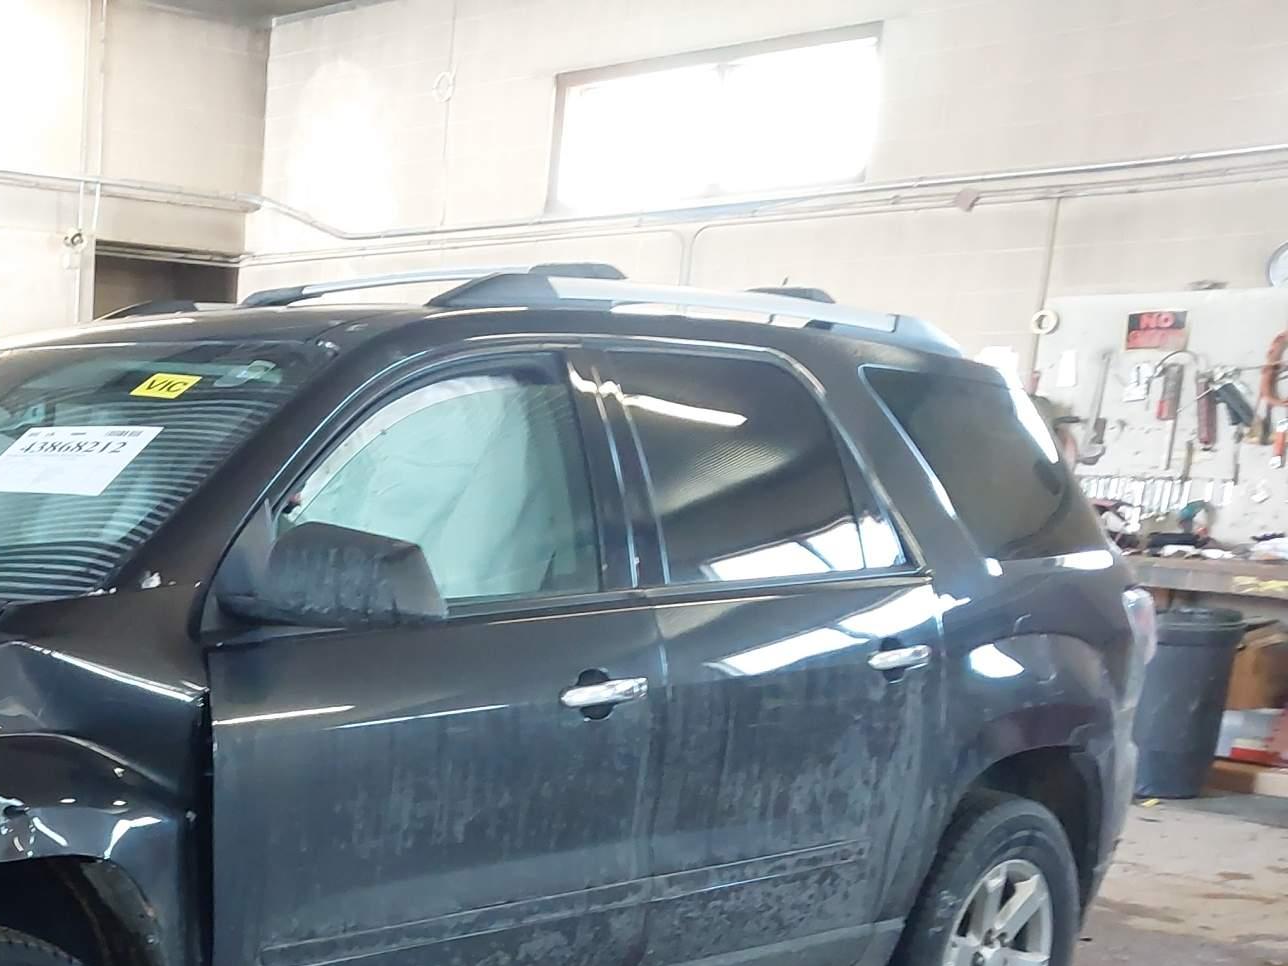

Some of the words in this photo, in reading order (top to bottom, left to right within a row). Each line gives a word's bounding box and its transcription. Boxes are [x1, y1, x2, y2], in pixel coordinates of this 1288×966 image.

[1140, 312, 1174, 328] NO
[145, 379, 187, 393] VIC
[20, 441, 127, 454] 43868212
